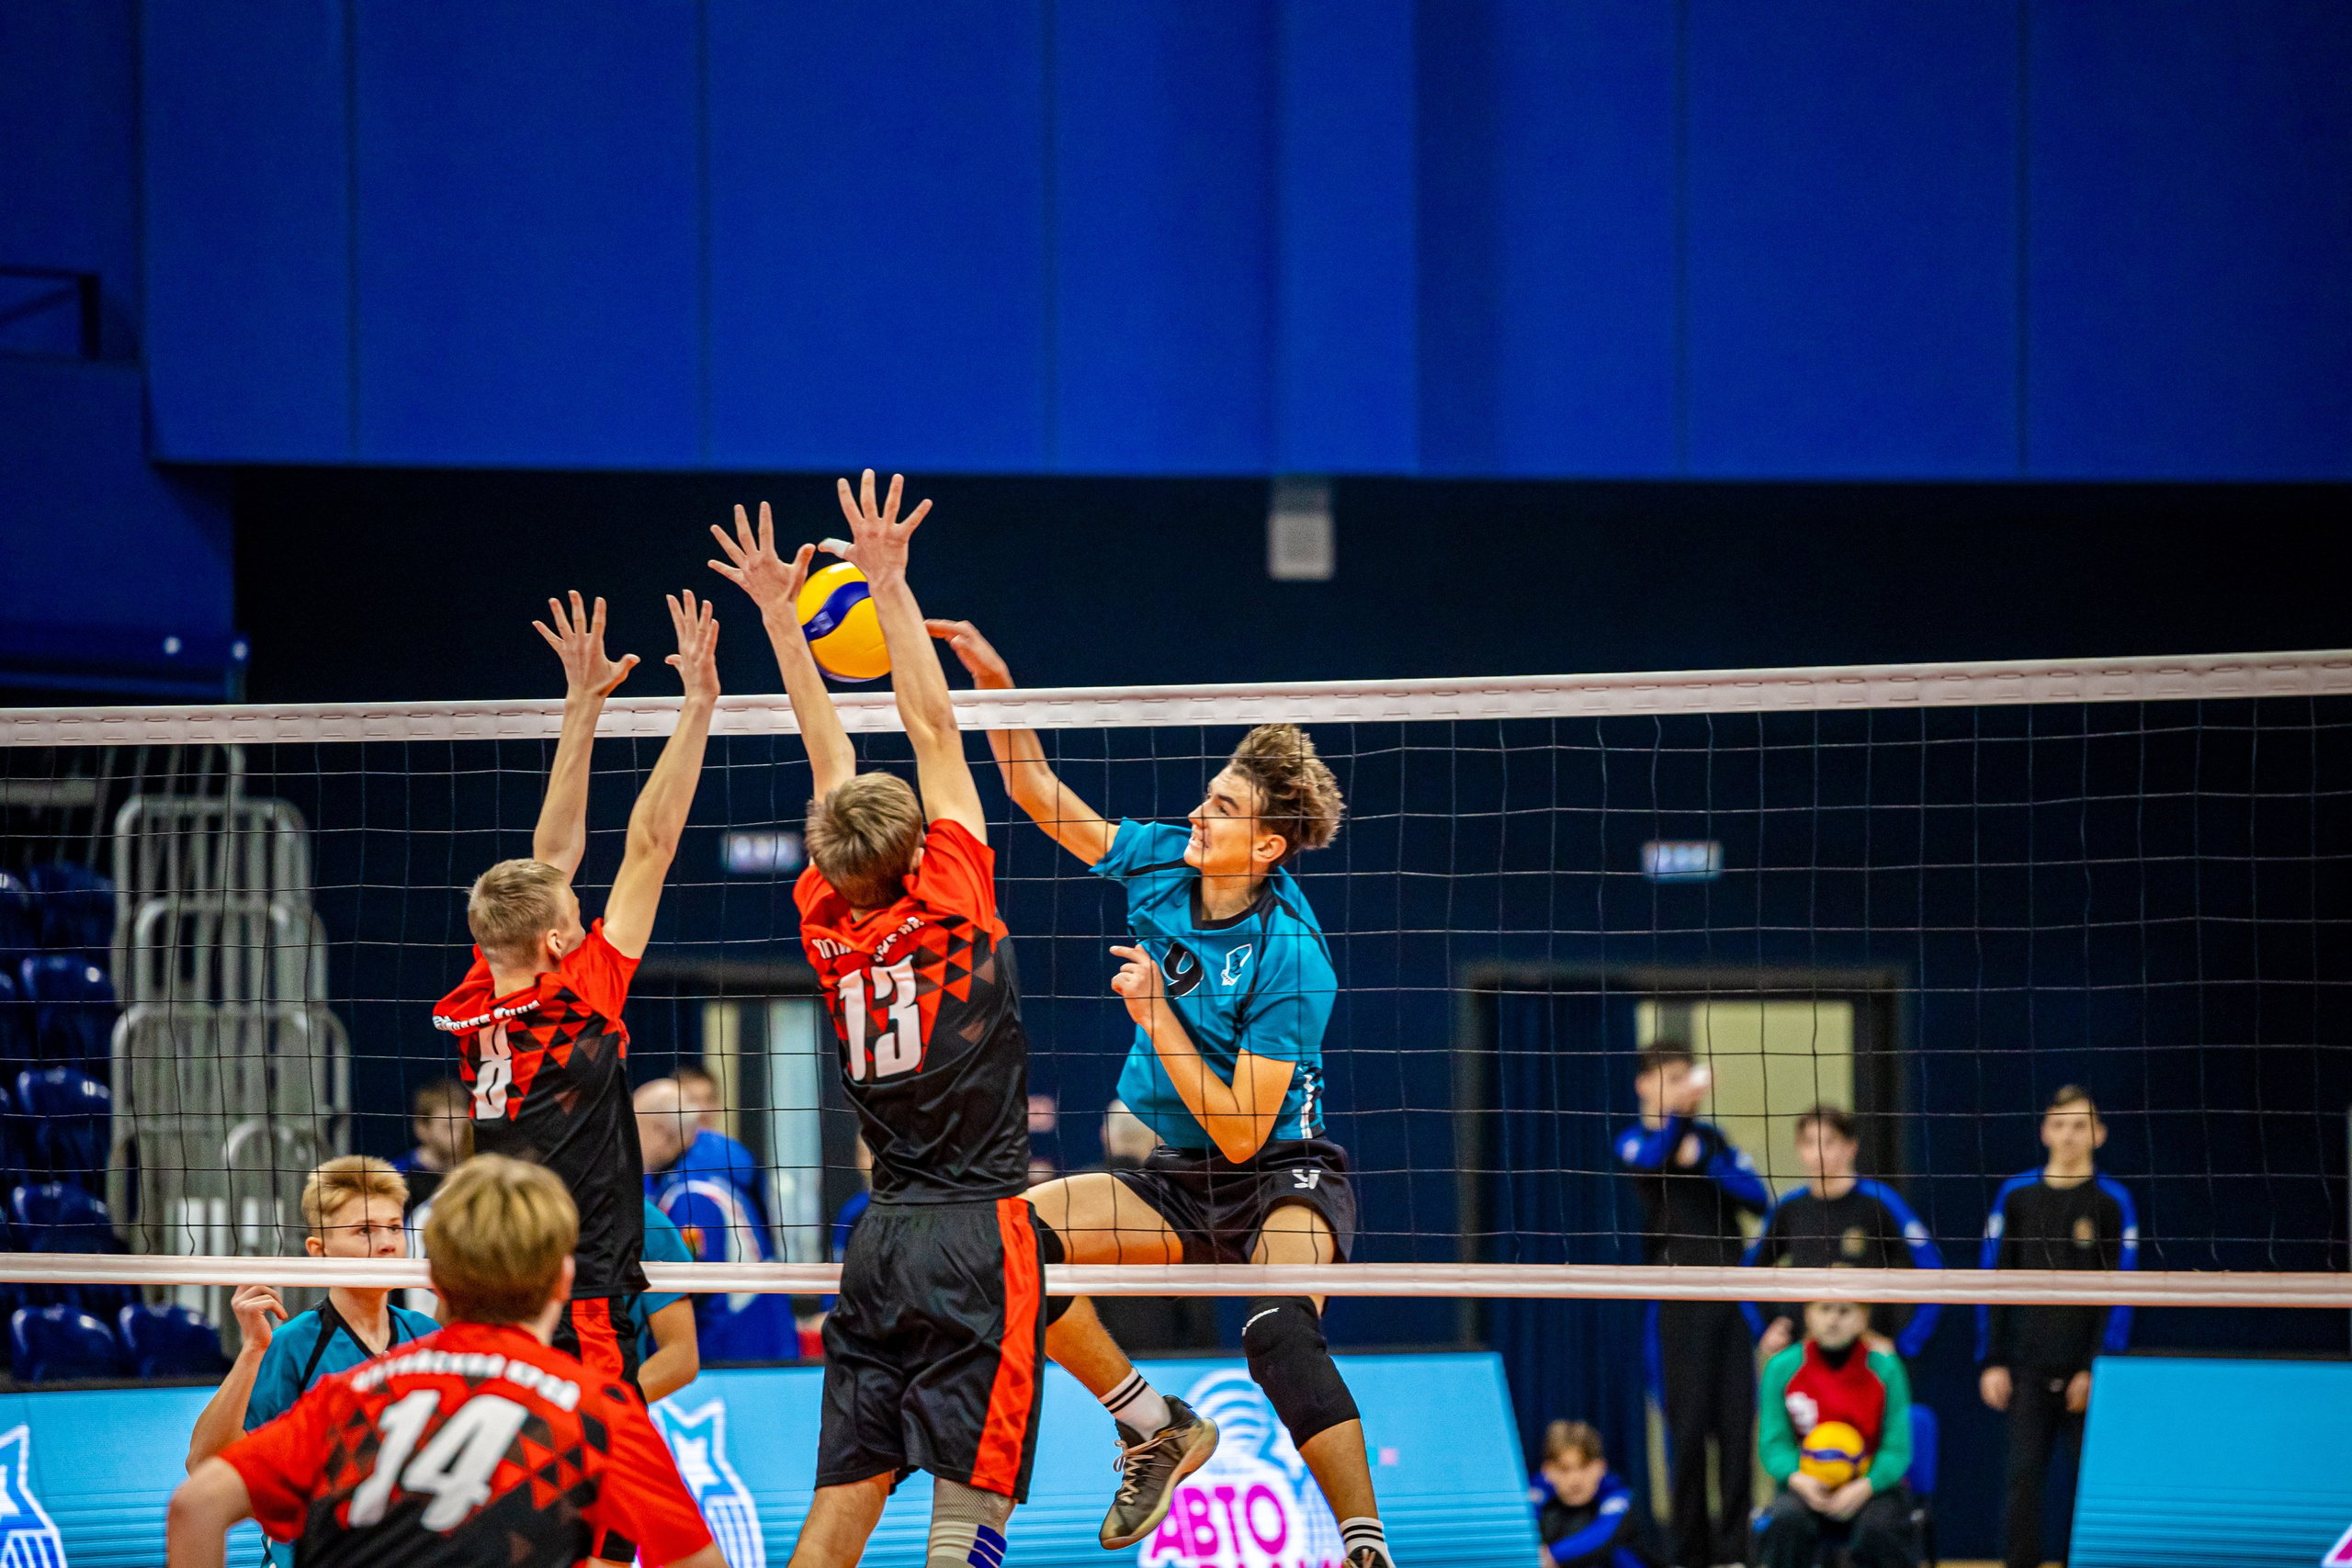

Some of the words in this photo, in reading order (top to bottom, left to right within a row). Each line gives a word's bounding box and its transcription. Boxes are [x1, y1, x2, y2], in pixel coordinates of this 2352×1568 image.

[837, 954, 922, 1081] 13
[1161, 942, 1205, 1000] 9
[471, 1018, 513, 1121] 8
[348, 1389, 529, 1532] 14
[1151, 1483, 1287, 1557] АВТО
